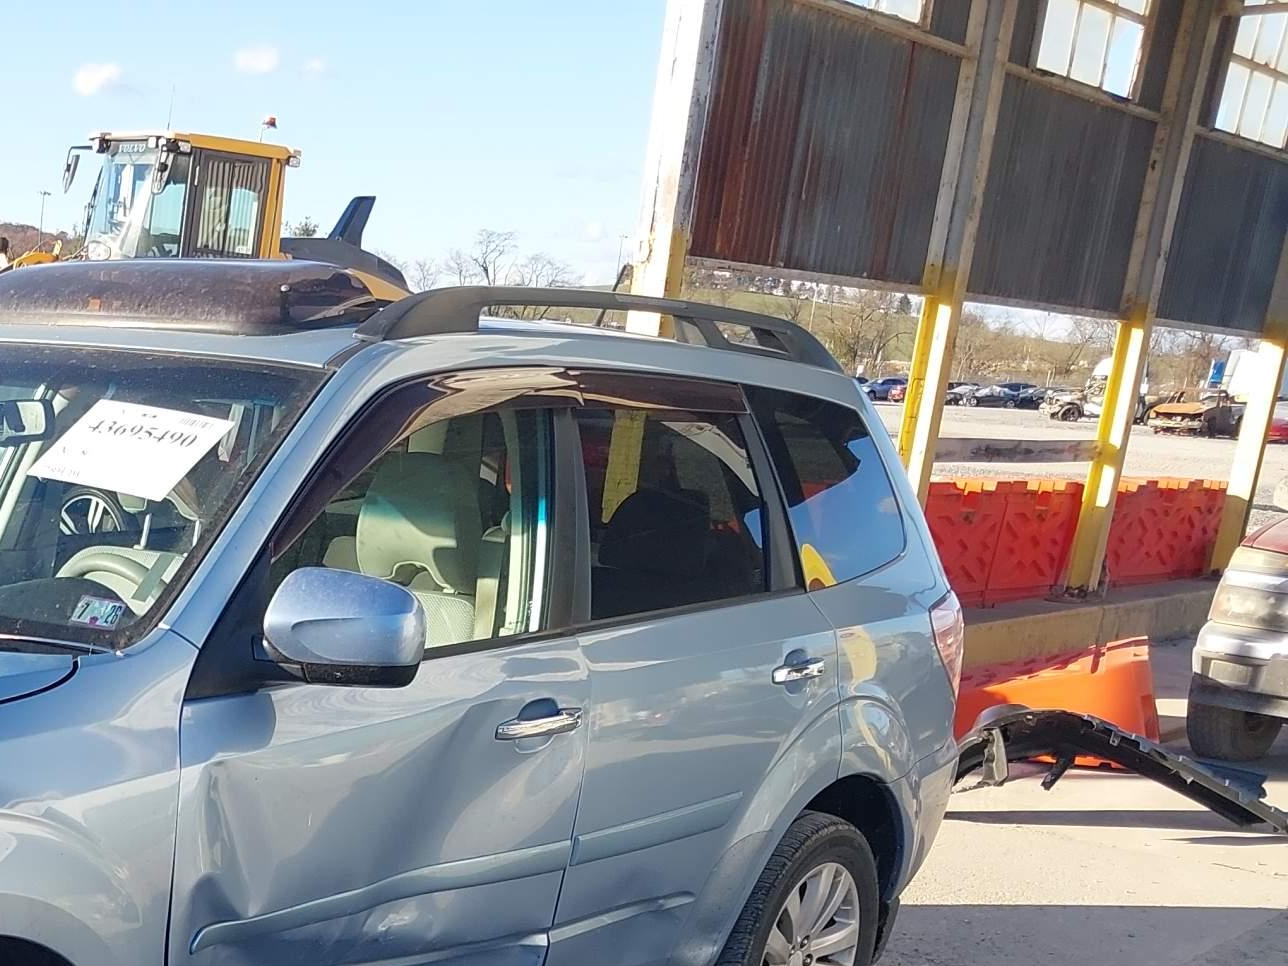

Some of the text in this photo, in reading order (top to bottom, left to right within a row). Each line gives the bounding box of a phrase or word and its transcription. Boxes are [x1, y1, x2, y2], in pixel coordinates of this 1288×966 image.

[118, 143, 146, 153] VOLVO
[88, 419, 199, 448] 43695490
[103, 604, 123, 625] 26
